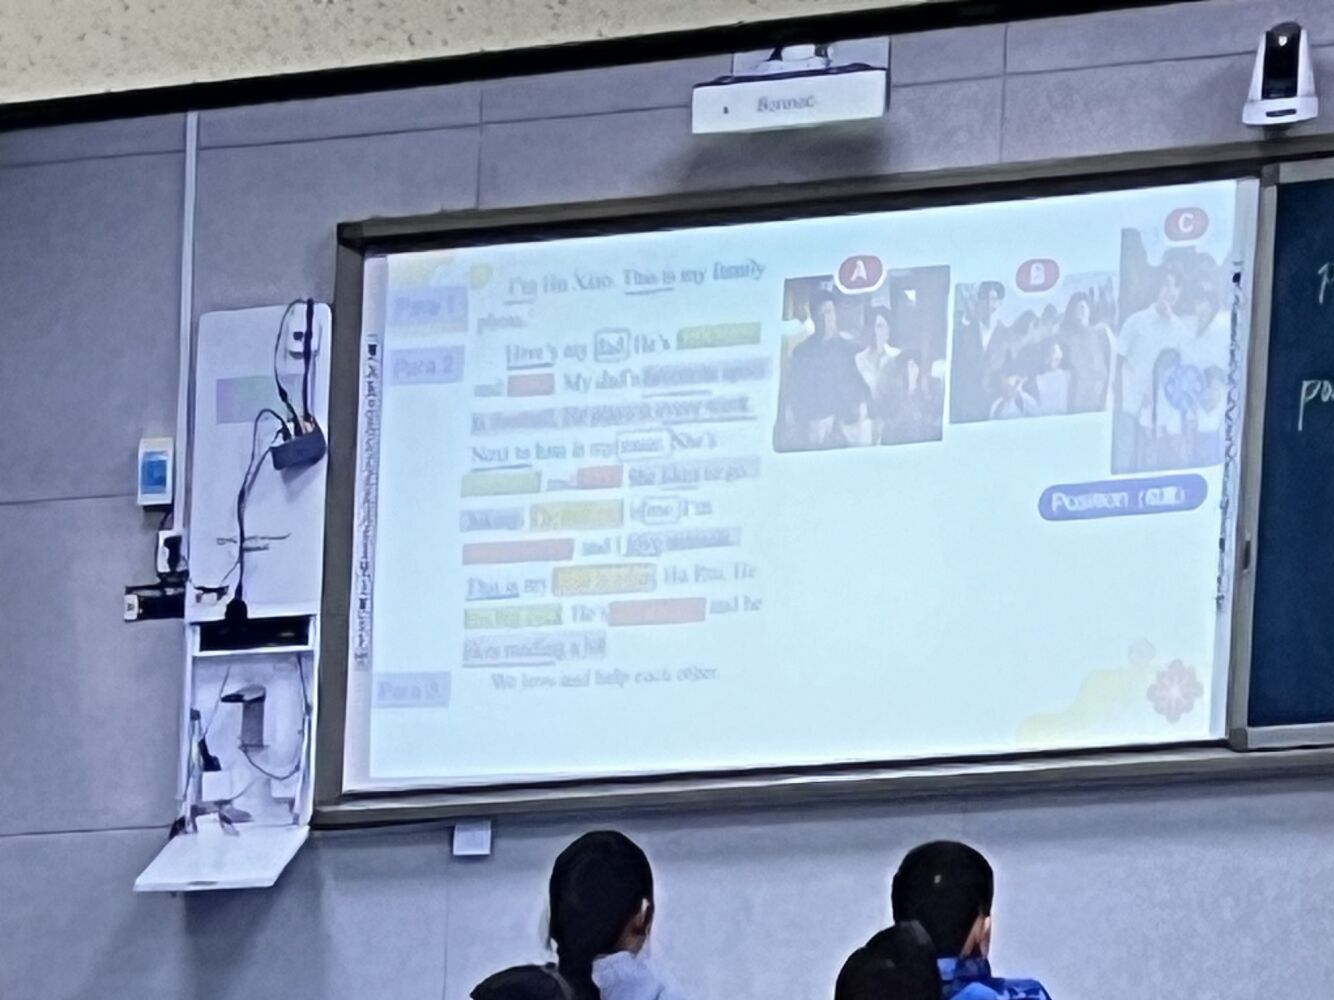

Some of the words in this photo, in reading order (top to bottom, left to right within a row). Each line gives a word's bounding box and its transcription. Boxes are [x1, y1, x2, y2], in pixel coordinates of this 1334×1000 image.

[1178, 212, 1195, 234] C
[850, 260, 869, 282] A
[1029, 264, 1046, 285] B
